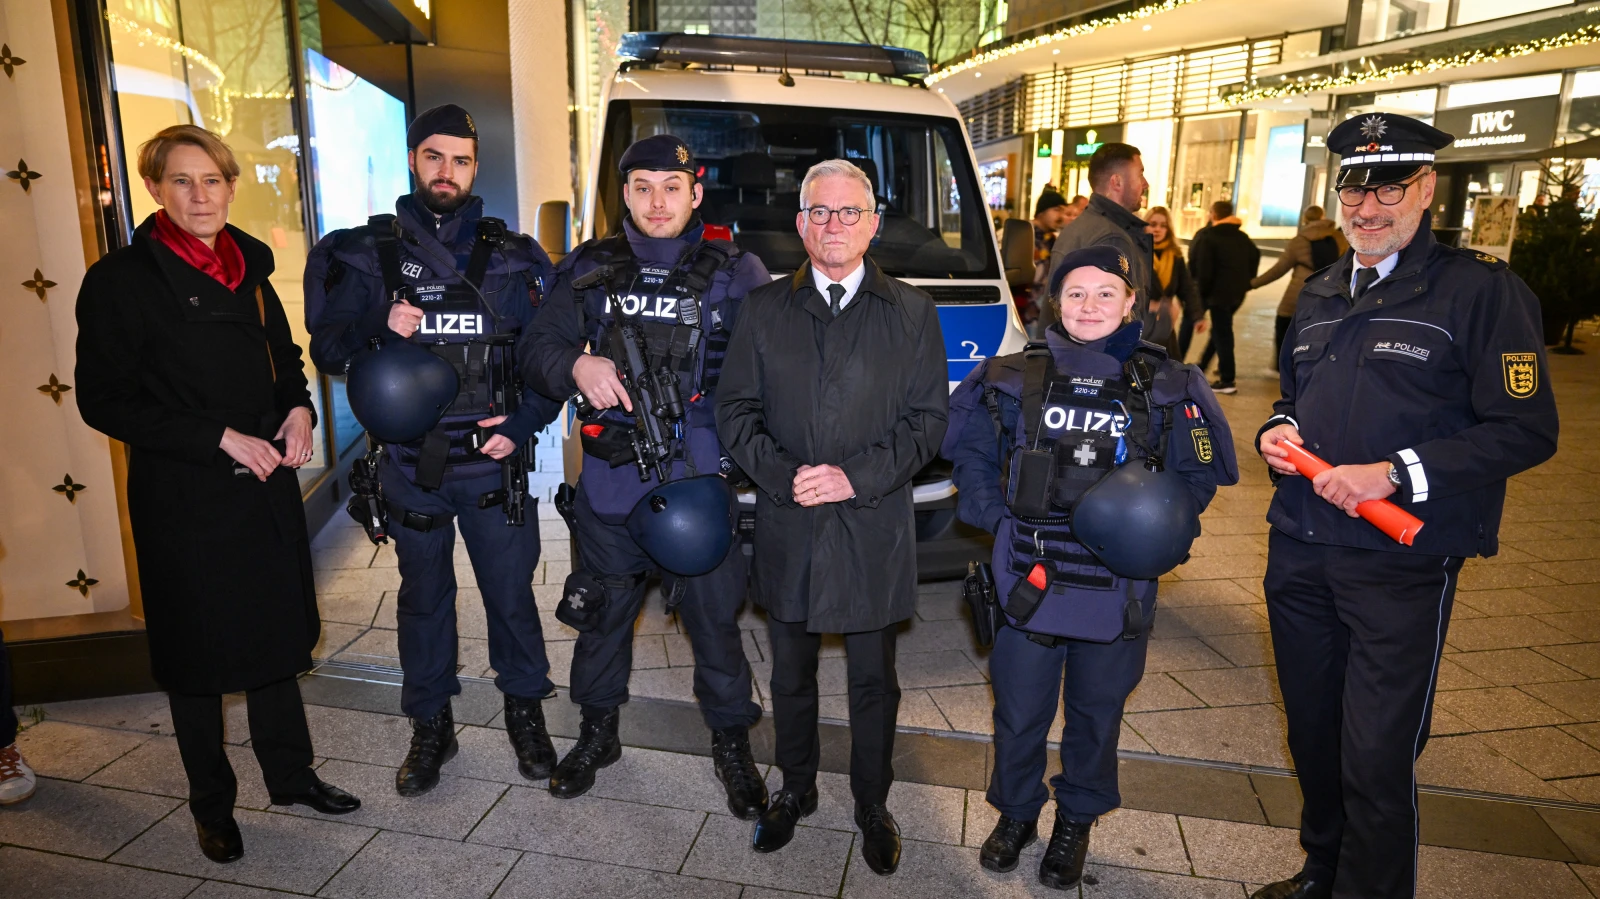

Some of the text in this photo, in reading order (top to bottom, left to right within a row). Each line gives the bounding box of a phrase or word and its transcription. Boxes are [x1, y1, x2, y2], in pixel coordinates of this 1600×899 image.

[1469, 110, 1515, 134] IWC
[401, 262, 423, 279] IZEI
[605, 294, 678, 318] POLIZ
[420, 314, 483, 334] LIZEI
[961, 340, 986, 359] 2
[1394, 342, 1430, 357] POLIZEI
[1074, 387, 1098, 395] 2210-22
[1044, 406, 1125, 437] OLIZE
